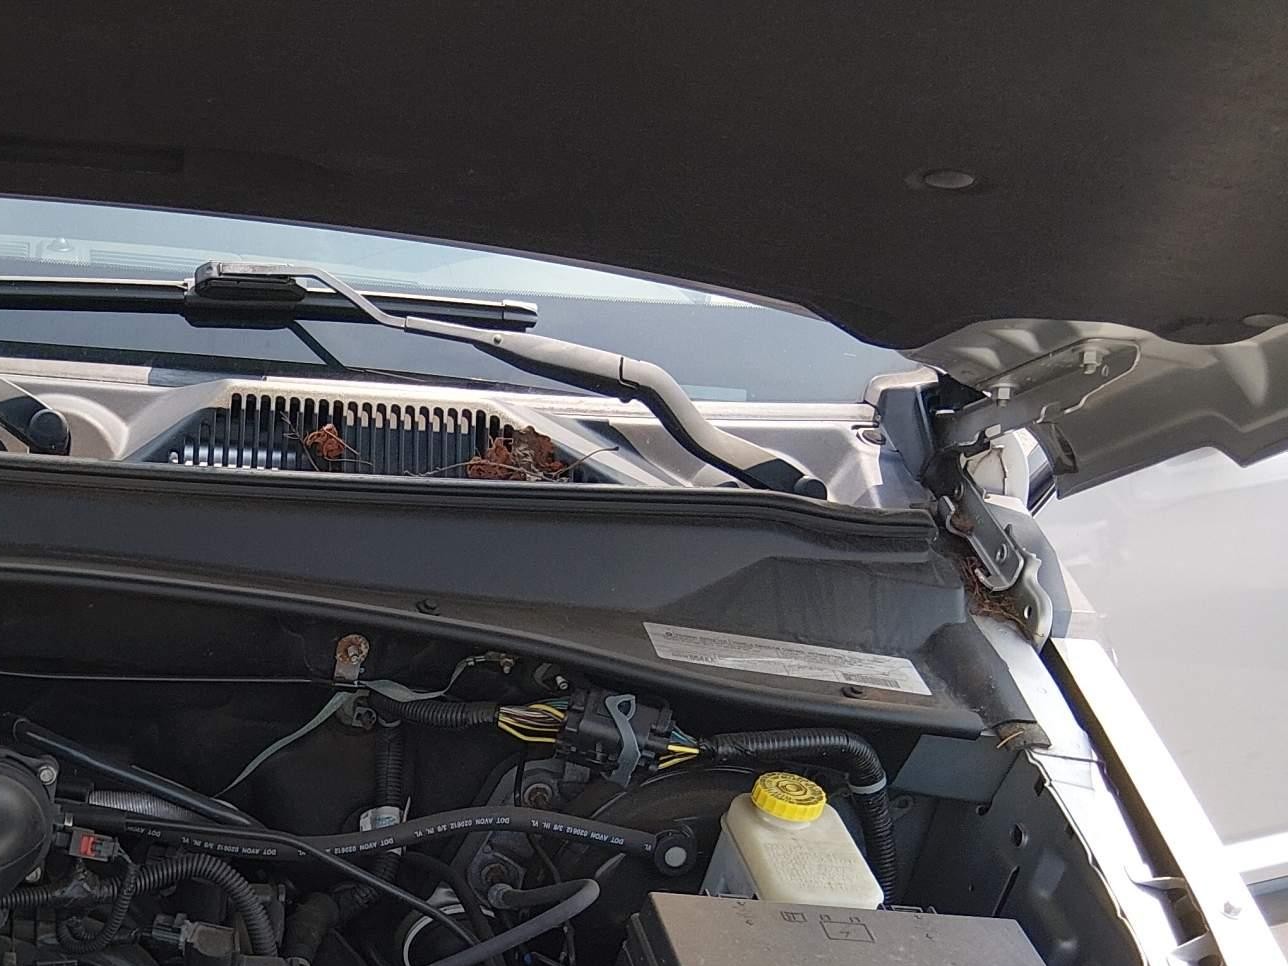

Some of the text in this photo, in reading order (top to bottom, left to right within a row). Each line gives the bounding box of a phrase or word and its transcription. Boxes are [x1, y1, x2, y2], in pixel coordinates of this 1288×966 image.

[475, 817, 494, 826] AVON
[495, 816, 510, 825] DOT
[590, 831, 609, 841] AVON
[359, 841, 377, 850] AVON
[379, 837, 394, 847] DOT
